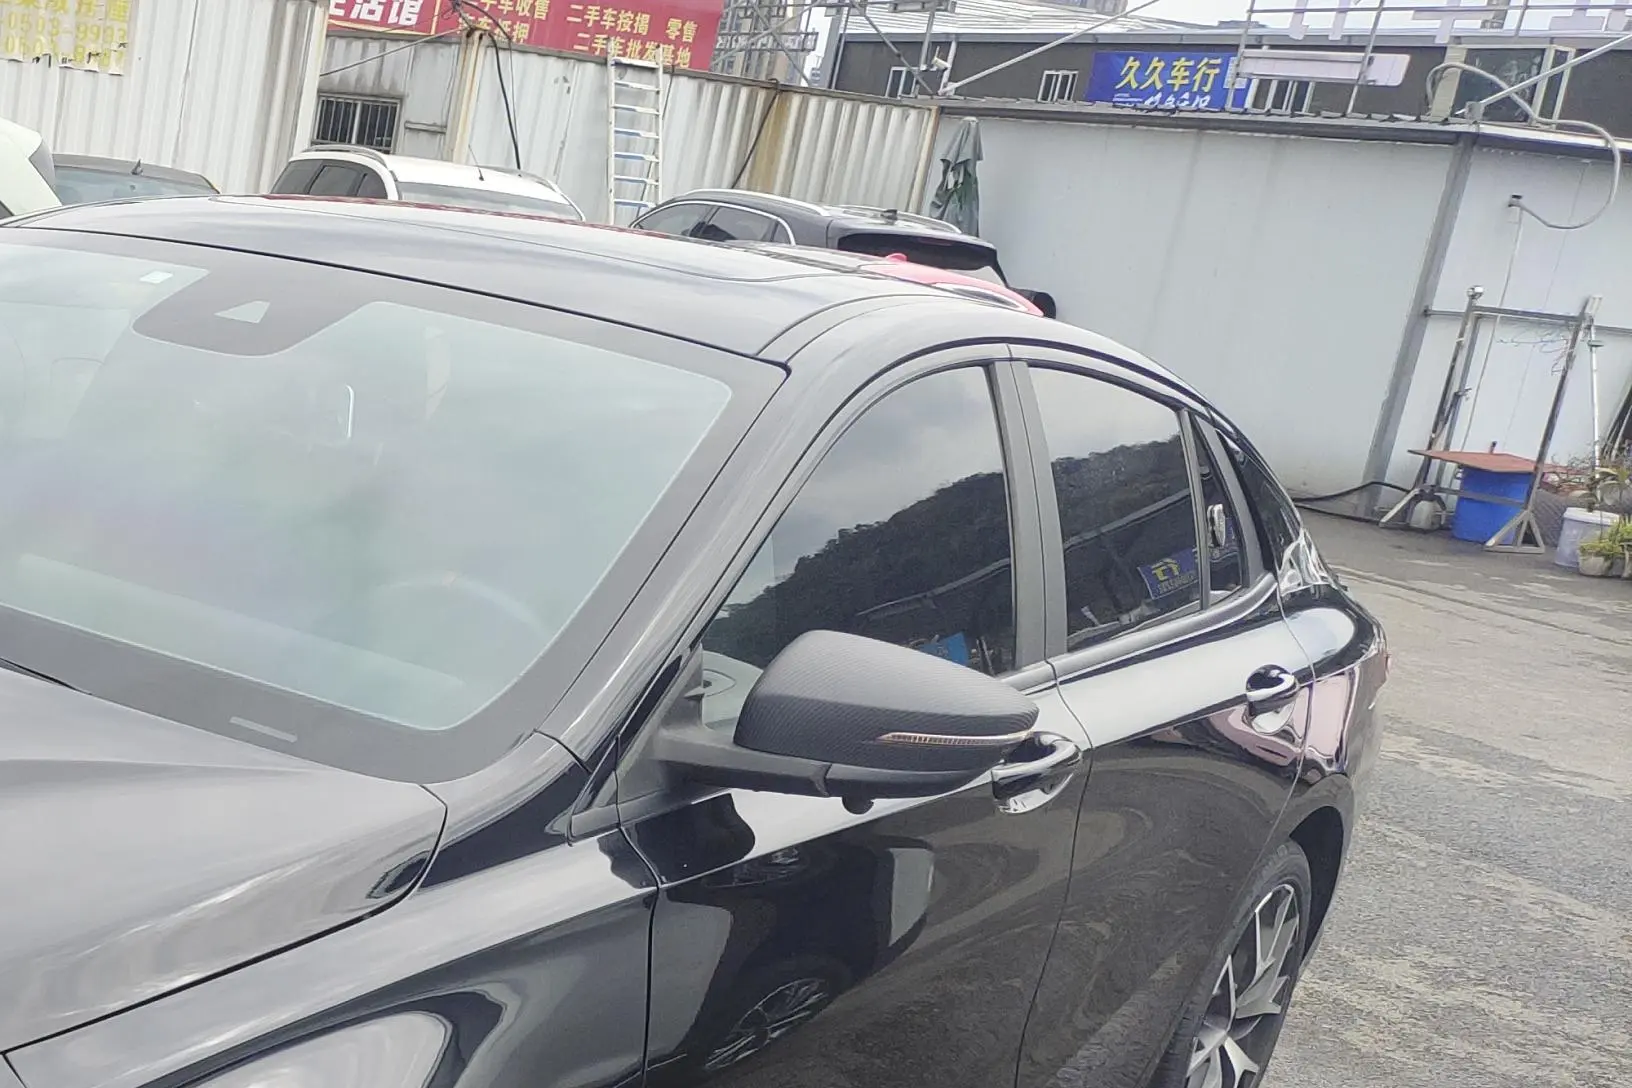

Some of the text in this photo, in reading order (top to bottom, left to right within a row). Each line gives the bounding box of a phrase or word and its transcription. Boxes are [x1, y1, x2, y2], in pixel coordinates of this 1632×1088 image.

[566, 4, 698, 43] 二手车按揭 零售
[1115, 56, 1222, 93] 久久车行
